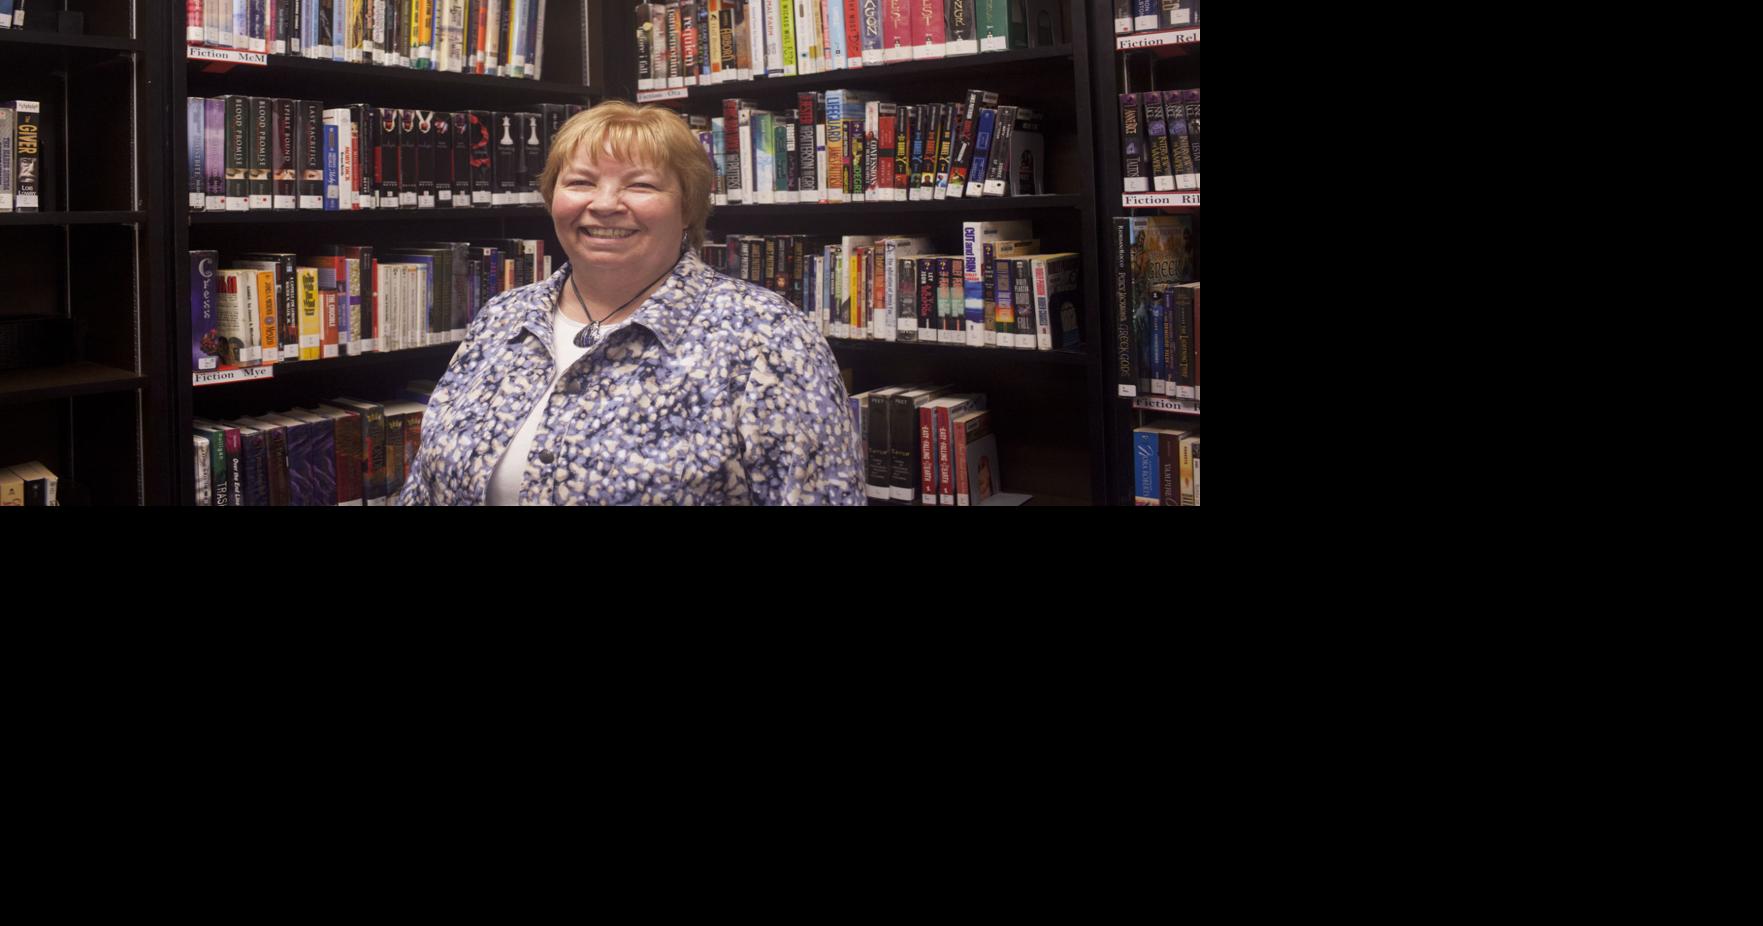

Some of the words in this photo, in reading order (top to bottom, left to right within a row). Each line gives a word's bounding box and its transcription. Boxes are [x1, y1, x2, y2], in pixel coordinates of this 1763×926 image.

[682, 17, 697, 66] requiem
[1120, 38, 1164, 49] Fiction
[1176, 33, 1197, 44] Rel
[190, 48, 229, 60] Fiction
[238, 50, 265, 63] McM
[828, 97, 842, 143] LIFEGUARD
[18, 124, 38, 154] GIVER
[801, 130, 815, 169] PATTERSON
[870, 140, 878, 185] CONFESSIONS
[1125, 196, 1170, 205] Fiction
[965, 227, 976, 243] CUT
[965, 243, 974, 256] and
[966, 256, 977, 272] RUN
[1119, 324, 1130, 353] GREEK
[1120, 354, 1132, 377] GODS
[195, 372, 235, 382] Fiction
[244, 368, 266, 378] Mye
[1136, 398, 1182, 410] Fiction
[232, 458, 240, 471] Over
